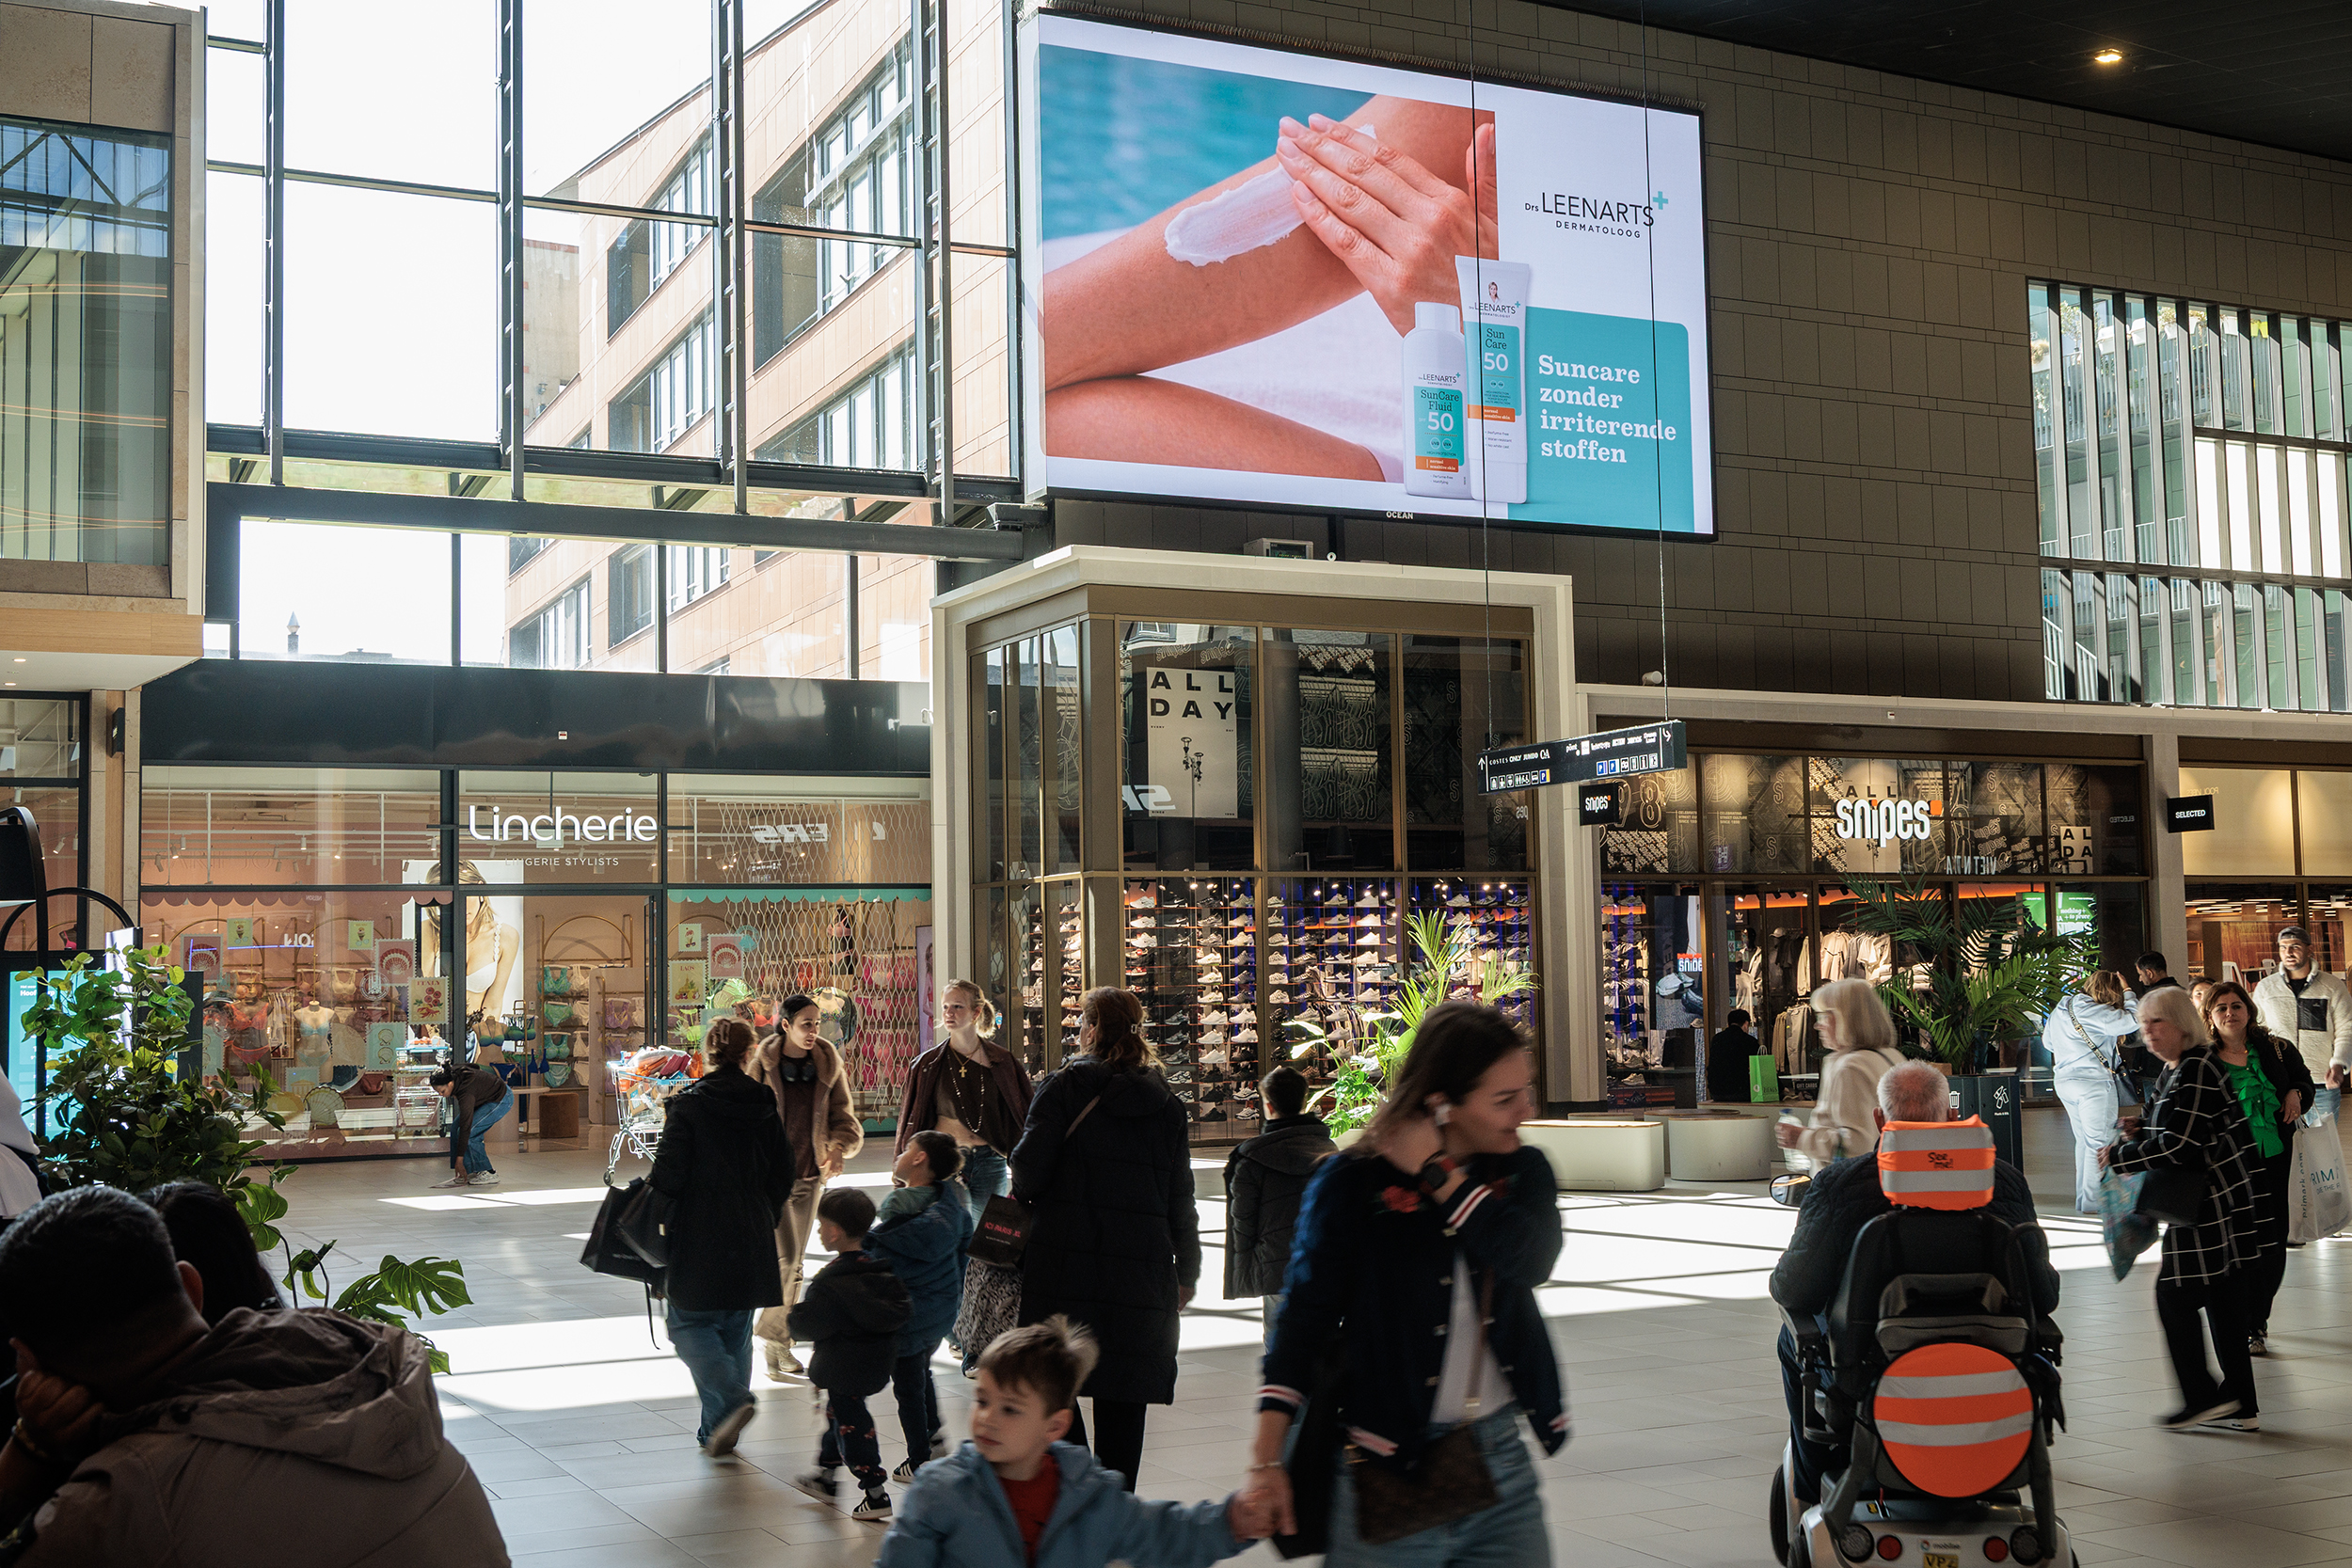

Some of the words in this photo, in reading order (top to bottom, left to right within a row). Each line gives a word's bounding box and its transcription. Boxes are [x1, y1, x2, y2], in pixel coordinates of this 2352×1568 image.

[1524, 203, 1539, 213] Drs
[1542, 192, 1654, 227] LEENARTS
[1556, 220, 1641, 239] DERMATOLOOG
[1474, 302, 1516, 314] LEENARTS
[1486, 327, 1505, 339] Sun
[1485, 339, 1507, 350] Care
[1484, 352, 1509, 372] 50
[1538, 354, 1640, 384] Suncare
[1422, 374, 1456, 384] LEENARTS
[1421, 389, 1459, 402] SunCare
[1539, 386, 1622, 408] zonder
[1428, 401, 1453, 412] Fluid
[1428, 412, 1454, 432] 50
[1540, 408, 1677, 441] irriterende
[1541, 439, 1627, 463] stoffen
[1151, 672, 1233, 693] ALL
[1151, 698, 1233, 720] DAY
[1846, 785, 1897, 798] ALL
[1584, 796, 1609, 813] snipes
[2175, 809, 2205, 818] SELECTED
[469, 805, 657, 841] Lincherie
[1836, 800, 1931, 847] snipes
[505, 858, 560, 866] LINGERIE
[565, 858, 619, 866] STYLISTS
